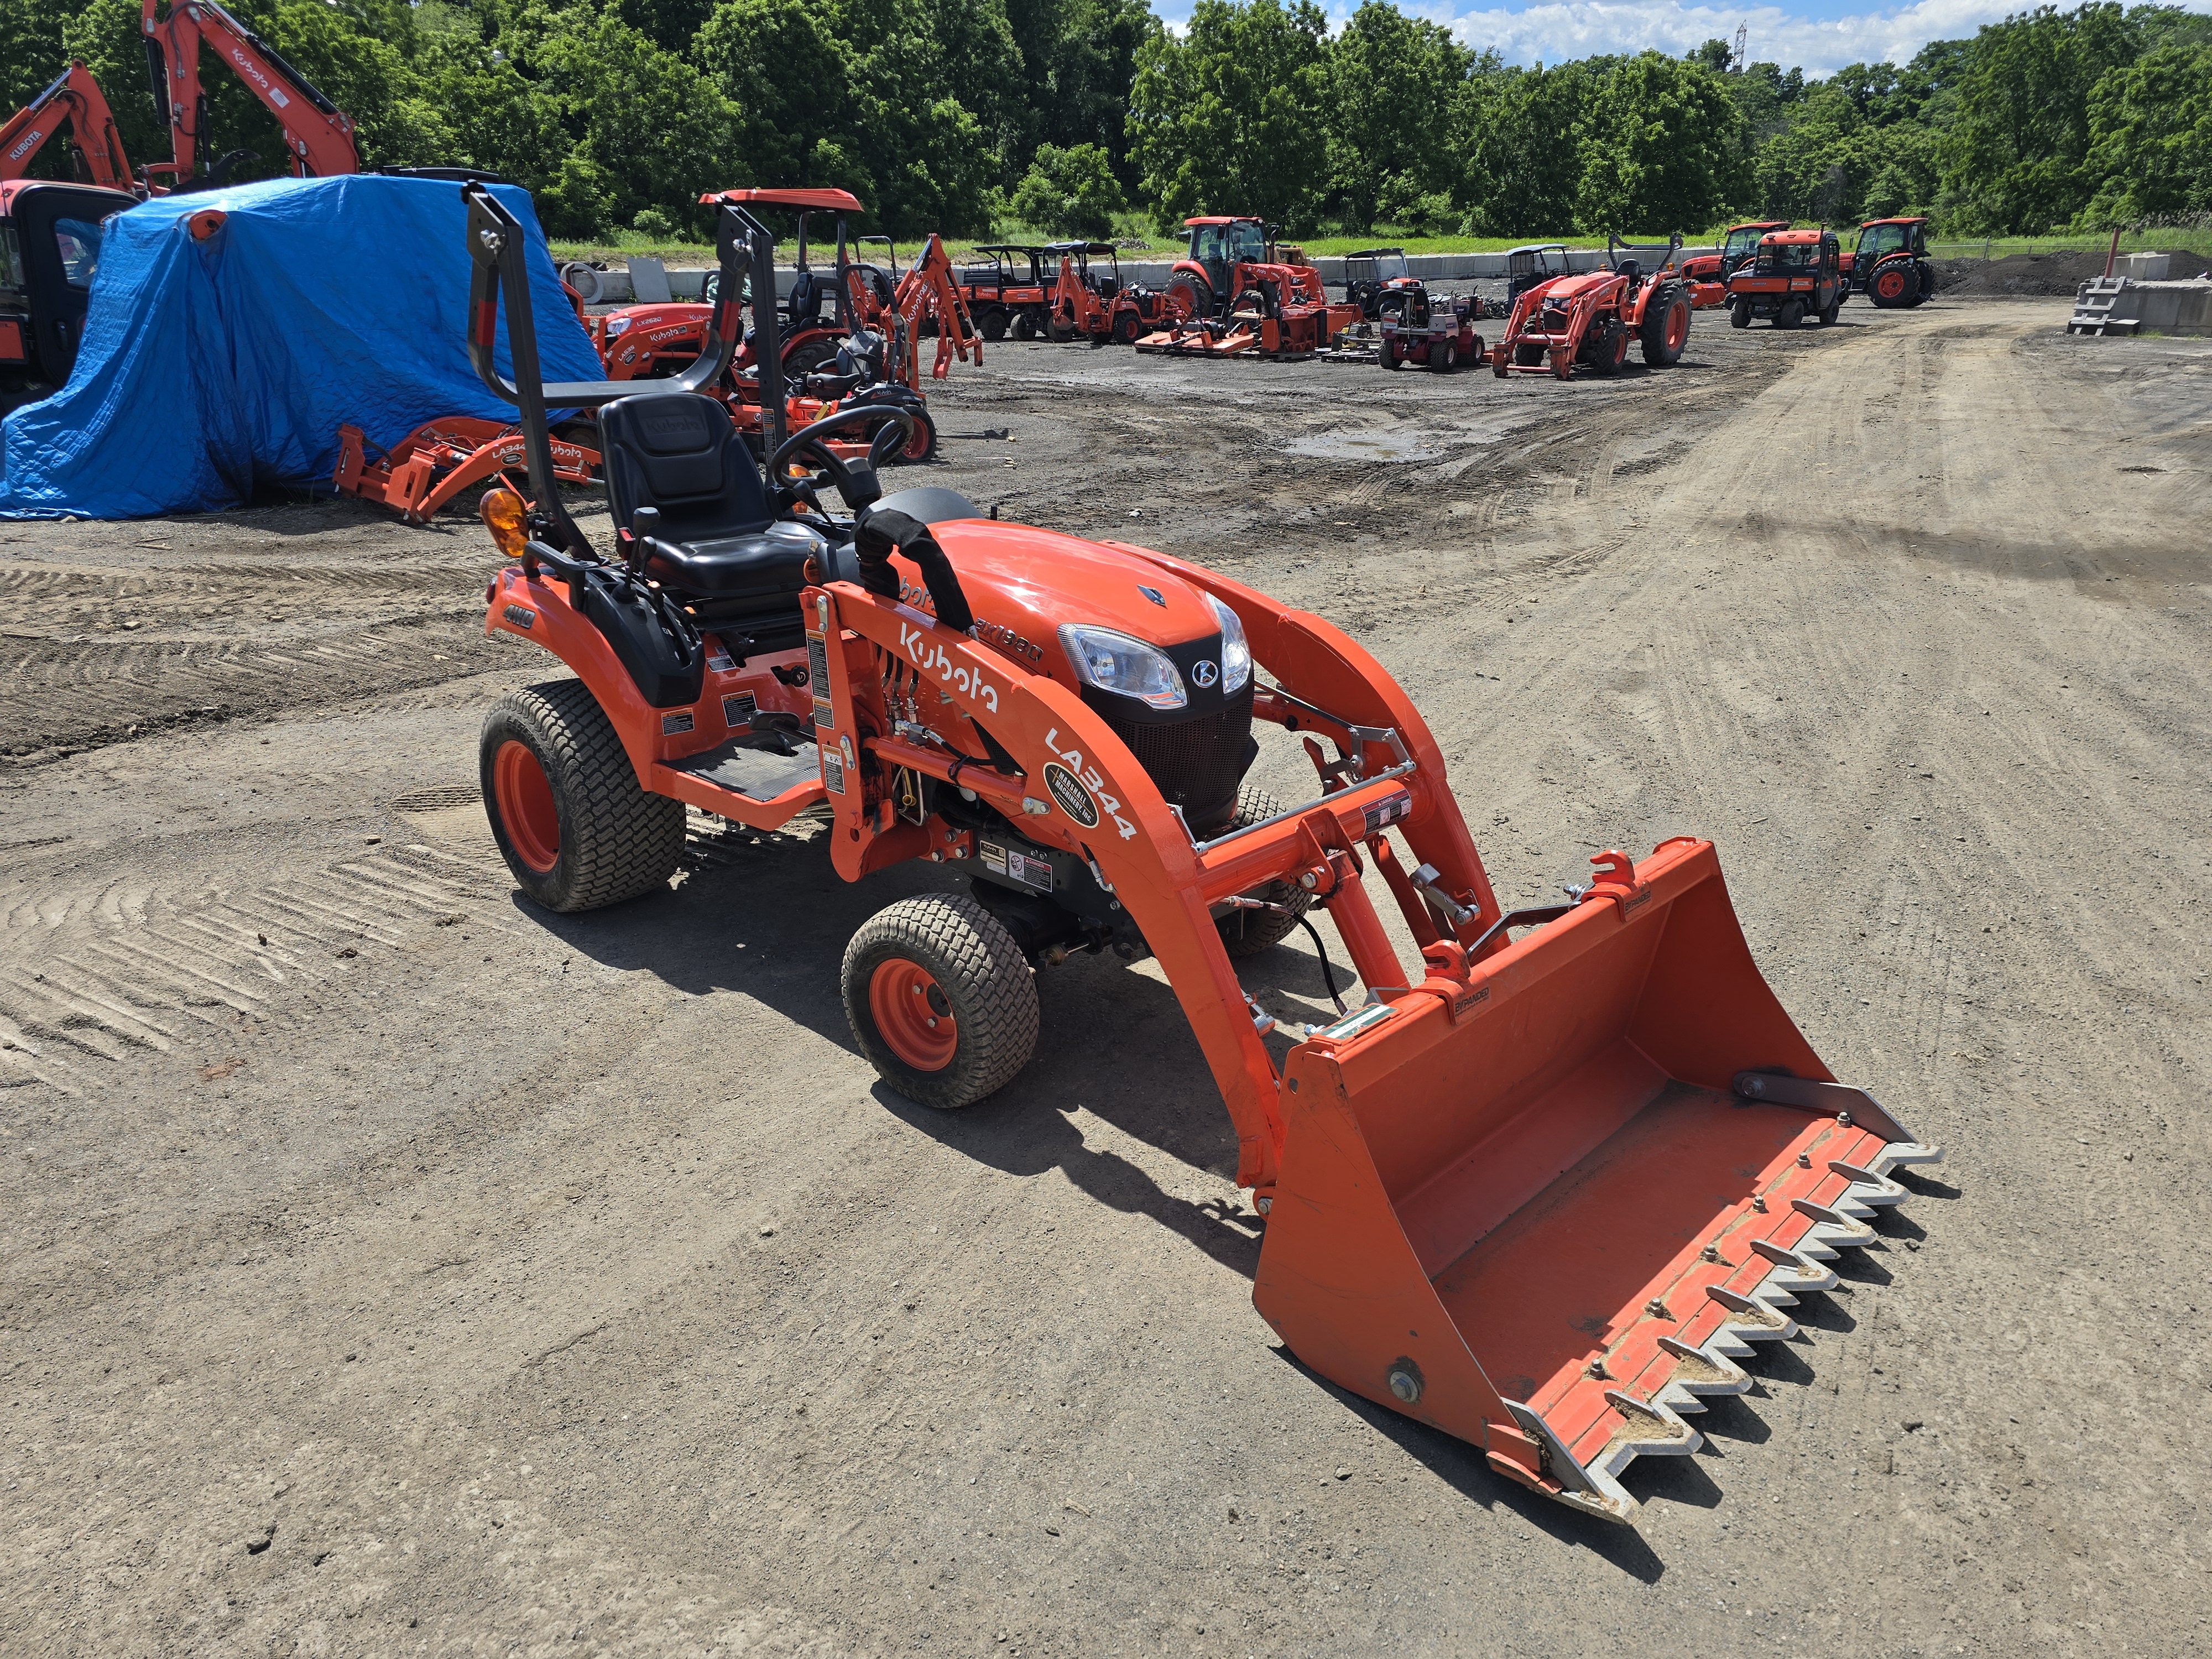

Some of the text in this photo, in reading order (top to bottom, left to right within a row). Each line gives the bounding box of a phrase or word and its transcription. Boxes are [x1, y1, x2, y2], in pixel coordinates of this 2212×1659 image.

[232, 49, 268, 88] Kubota
[9, 131, 42, 160] KUBOTA
[906, 284, 927, 322] Kubota
[637, 317, 661, 326] LX2620
[650, 328, 679, 341] Kubota
[618, 345, 635, 361] LA535
[550, 444, 582, 458] ubota
[503, 603, 535, 629] 4WD
[900, 622, 998, 713] Kubota
[1045, 727, 1137, 840] LA344
[1058, 771, 1087, 804] MARSHALL
[1055, 779, 1083, 813] MACHINERY,
[1082, 808, 1091, 823] Inc.
[1029, 859, 1044, 868] DANGER
